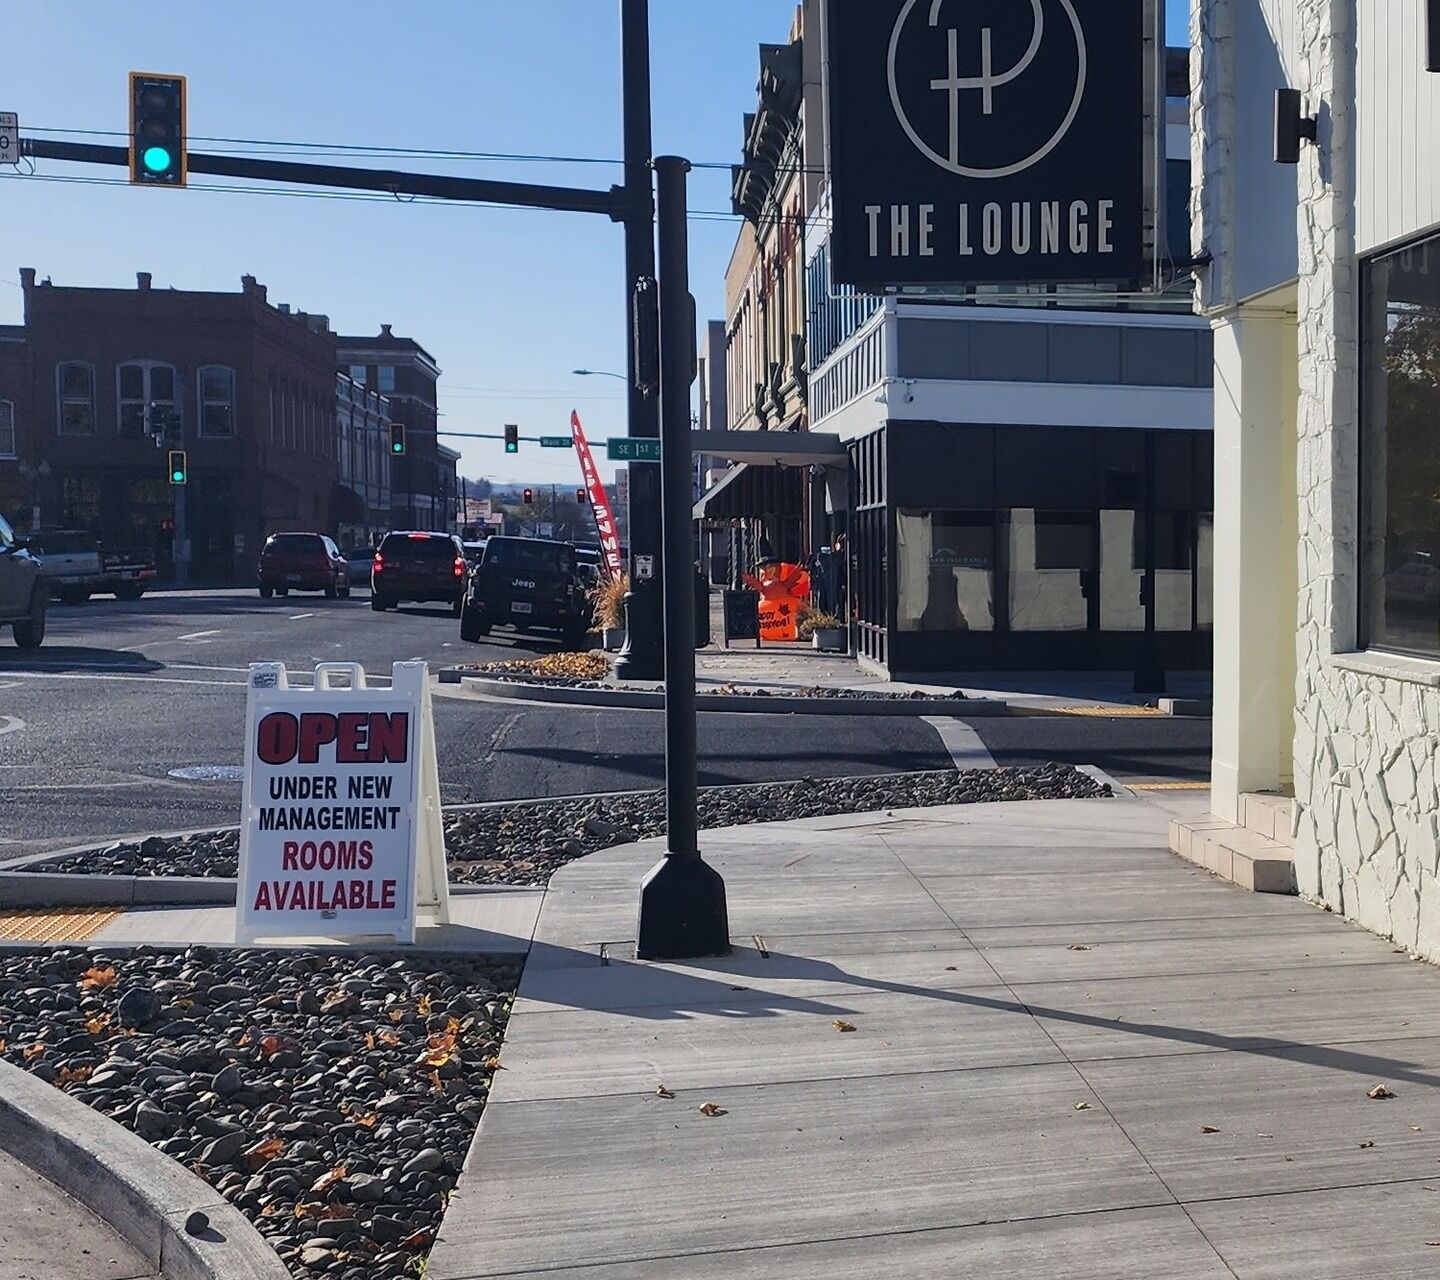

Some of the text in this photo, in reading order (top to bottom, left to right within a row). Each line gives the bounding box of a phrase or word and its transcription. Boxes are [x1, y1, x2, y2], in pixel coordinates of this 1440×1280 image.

[864, 199, 1114, 257] THE LOUNGE
[618, 444, 630, 455] SE
[635, 443, 649, 457] 1st
[511, 578, 536, 590] Jeep
[257, 711, 409, 765] OPEN
[269, 775, 393, 800] UNDER NEW
[258, 806, 401, 831] MANAGEMENT
[282, 840, 374, 871] ROOMS
[253, 879, 397, 911] AVAILABLE
